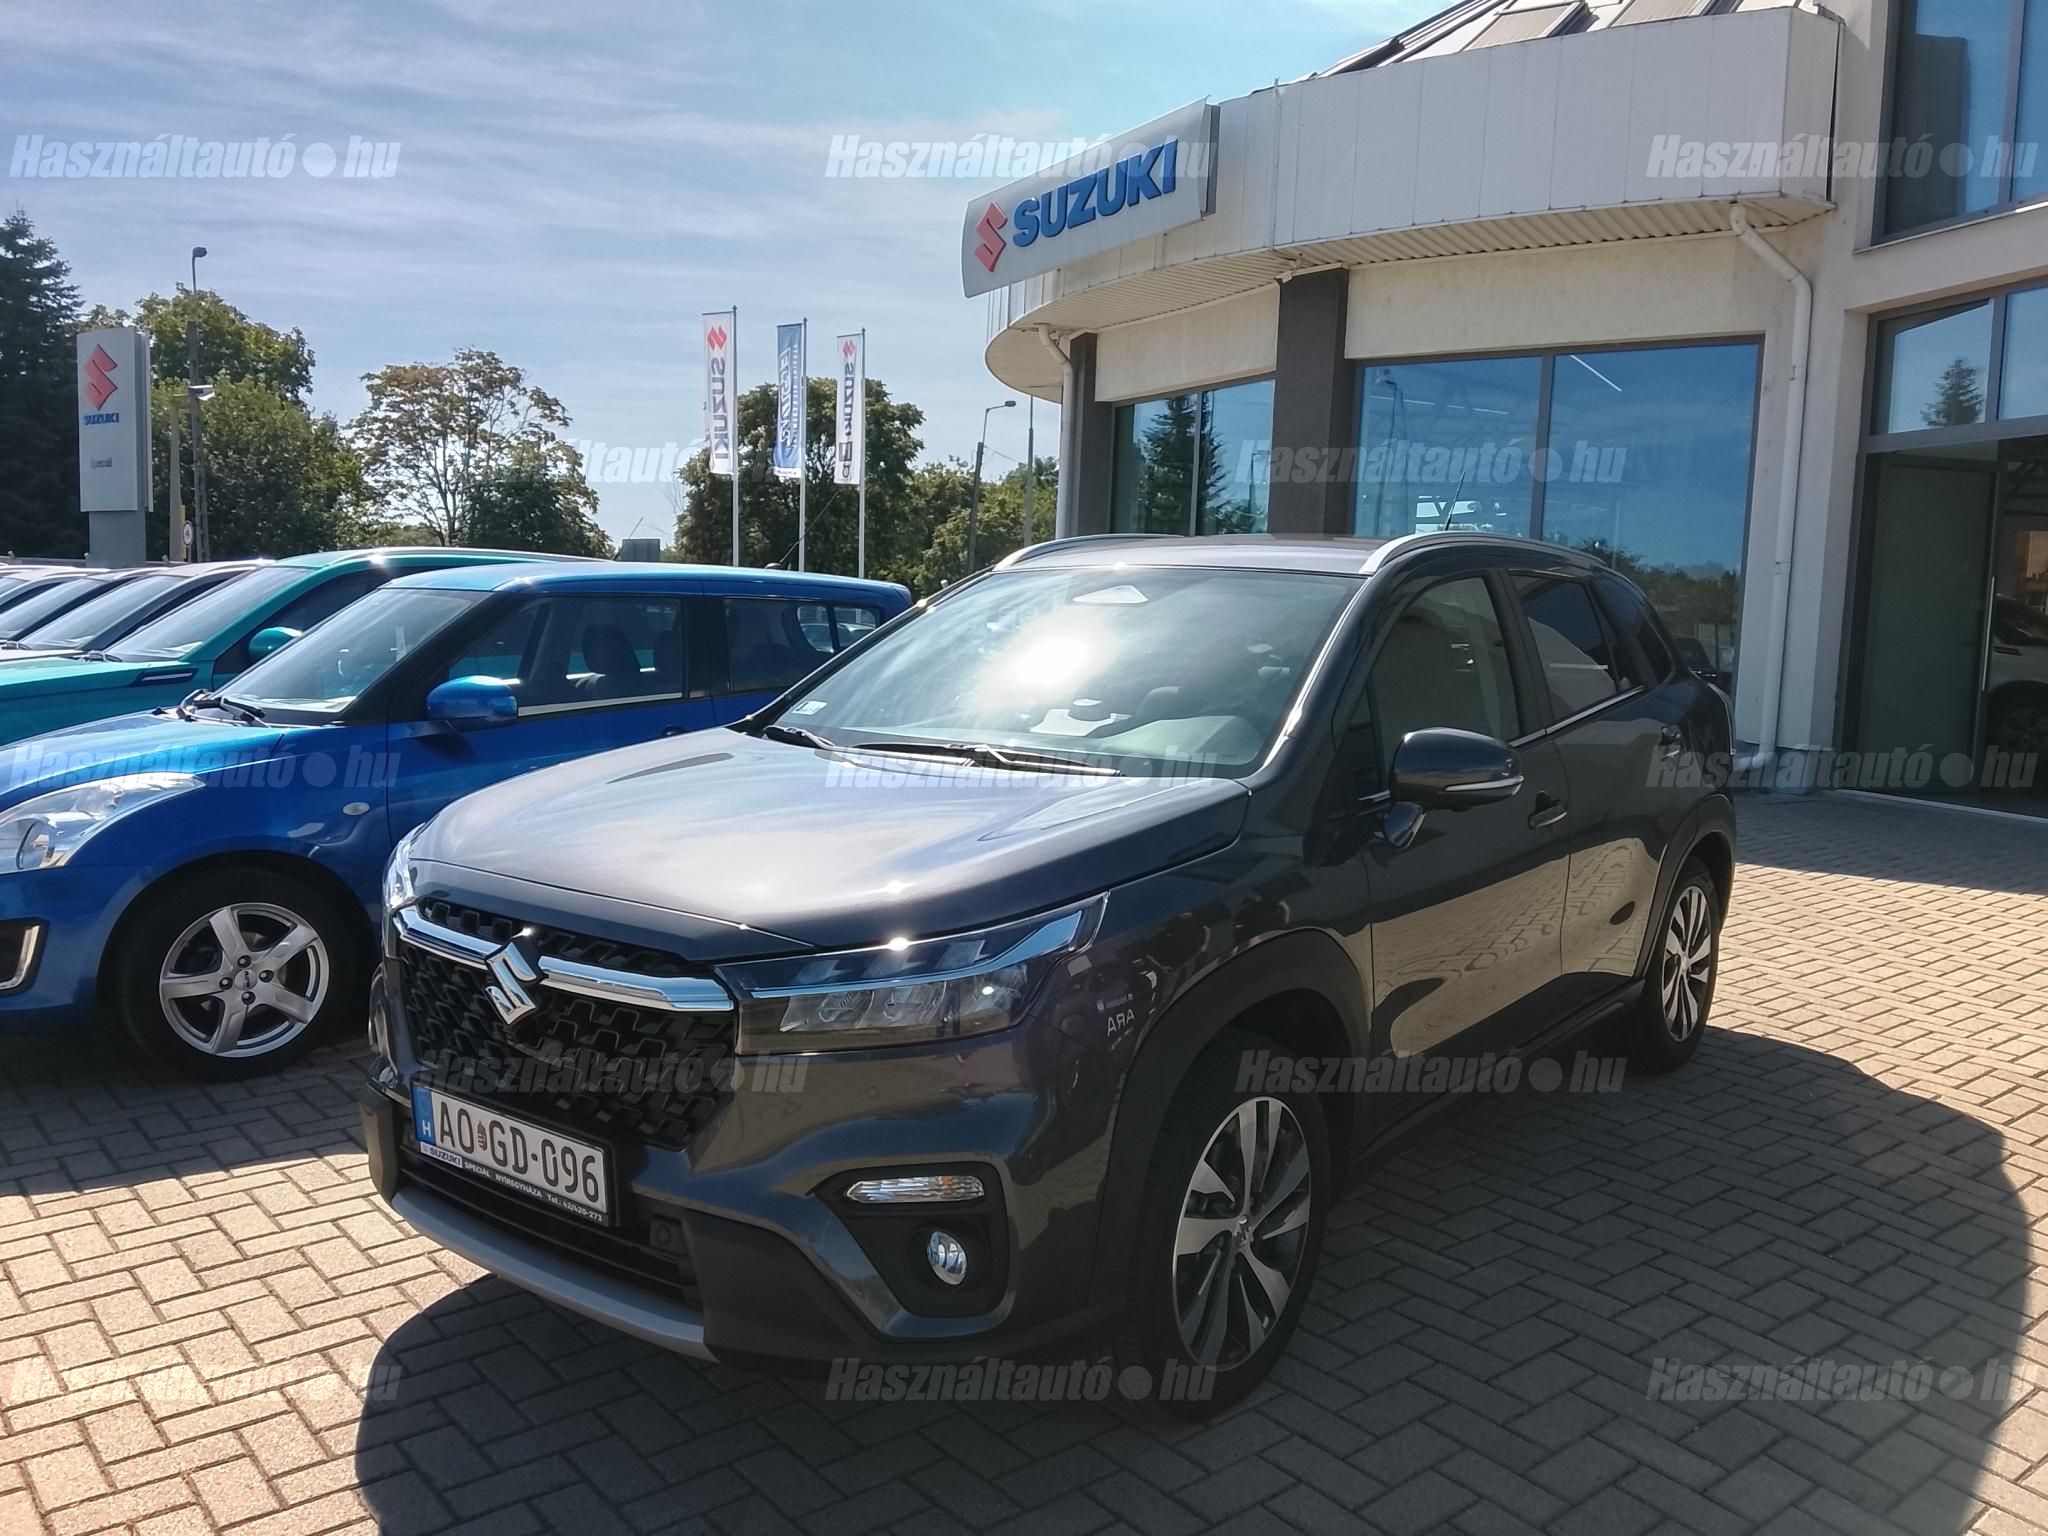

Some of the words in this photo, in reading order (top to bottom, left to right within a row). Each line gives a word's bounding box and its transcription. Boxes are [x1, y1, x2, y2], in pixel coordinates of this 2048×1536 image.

[1012, 139, 1178, 247] SUZUKI
[422, 1119, 431, 1137] H
[440, 1101, 475, 1154] AO
[429, 1147, 461, 1166] SUZUKI
